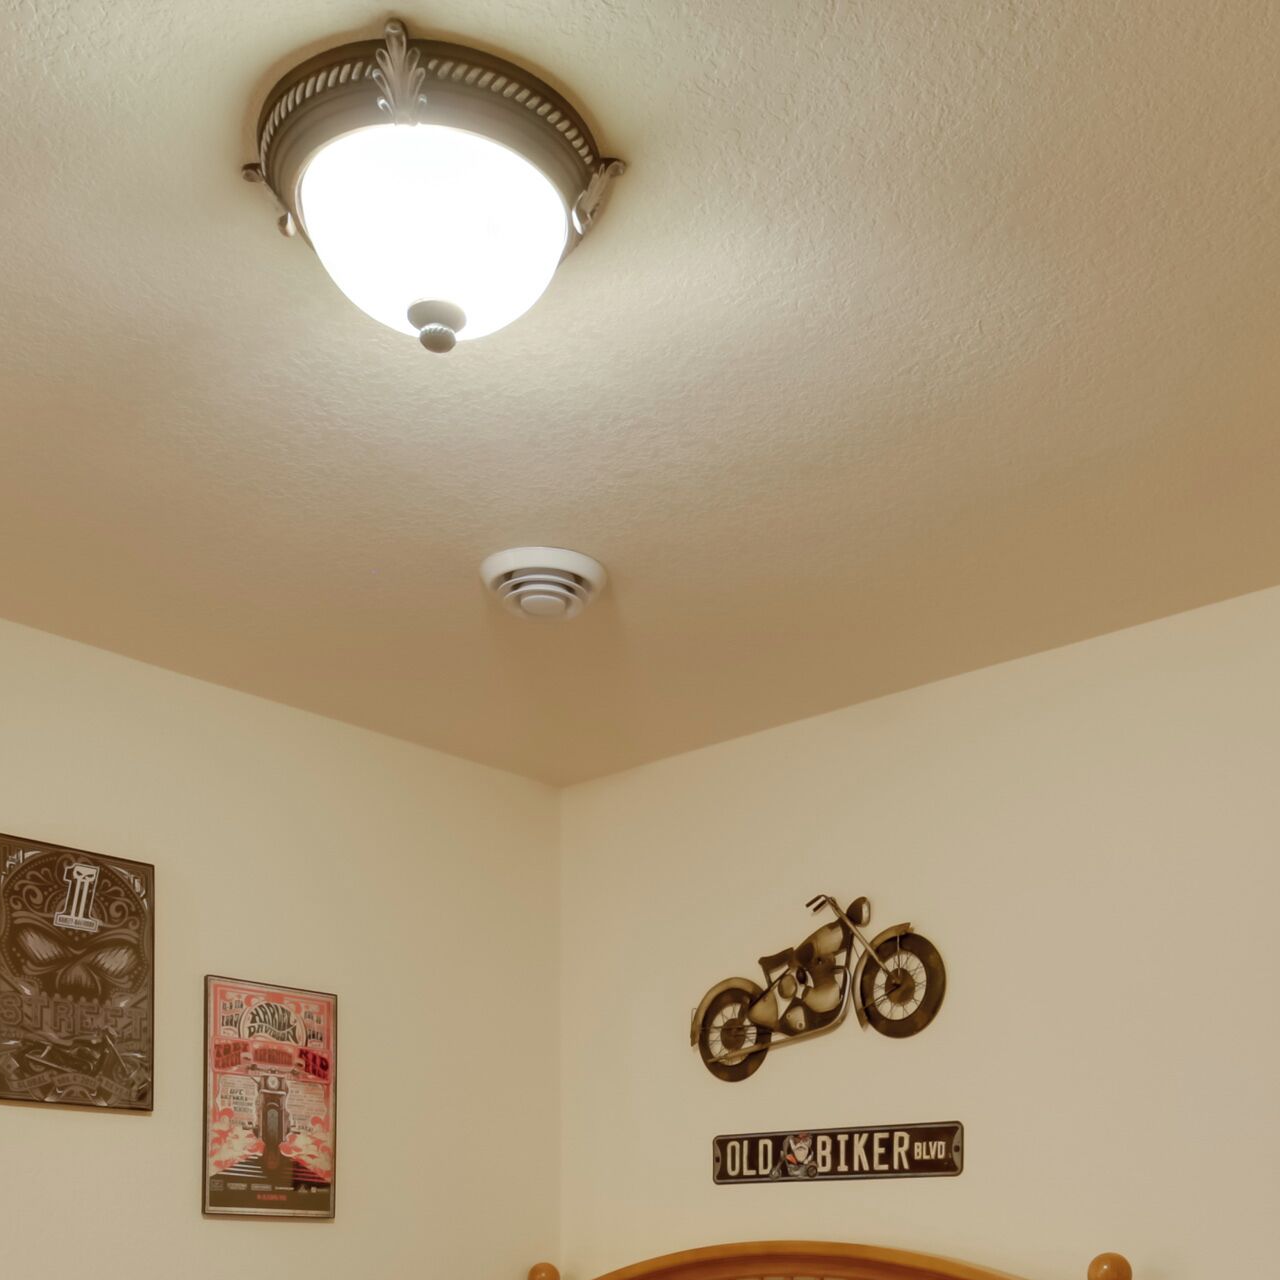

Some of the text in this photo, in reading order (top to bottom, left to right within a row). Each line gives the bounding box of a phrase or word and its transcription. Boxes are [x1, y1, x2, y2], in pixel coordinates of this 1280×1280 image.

[726, 1131, 947, 1177] OLD BIKER BLVD
